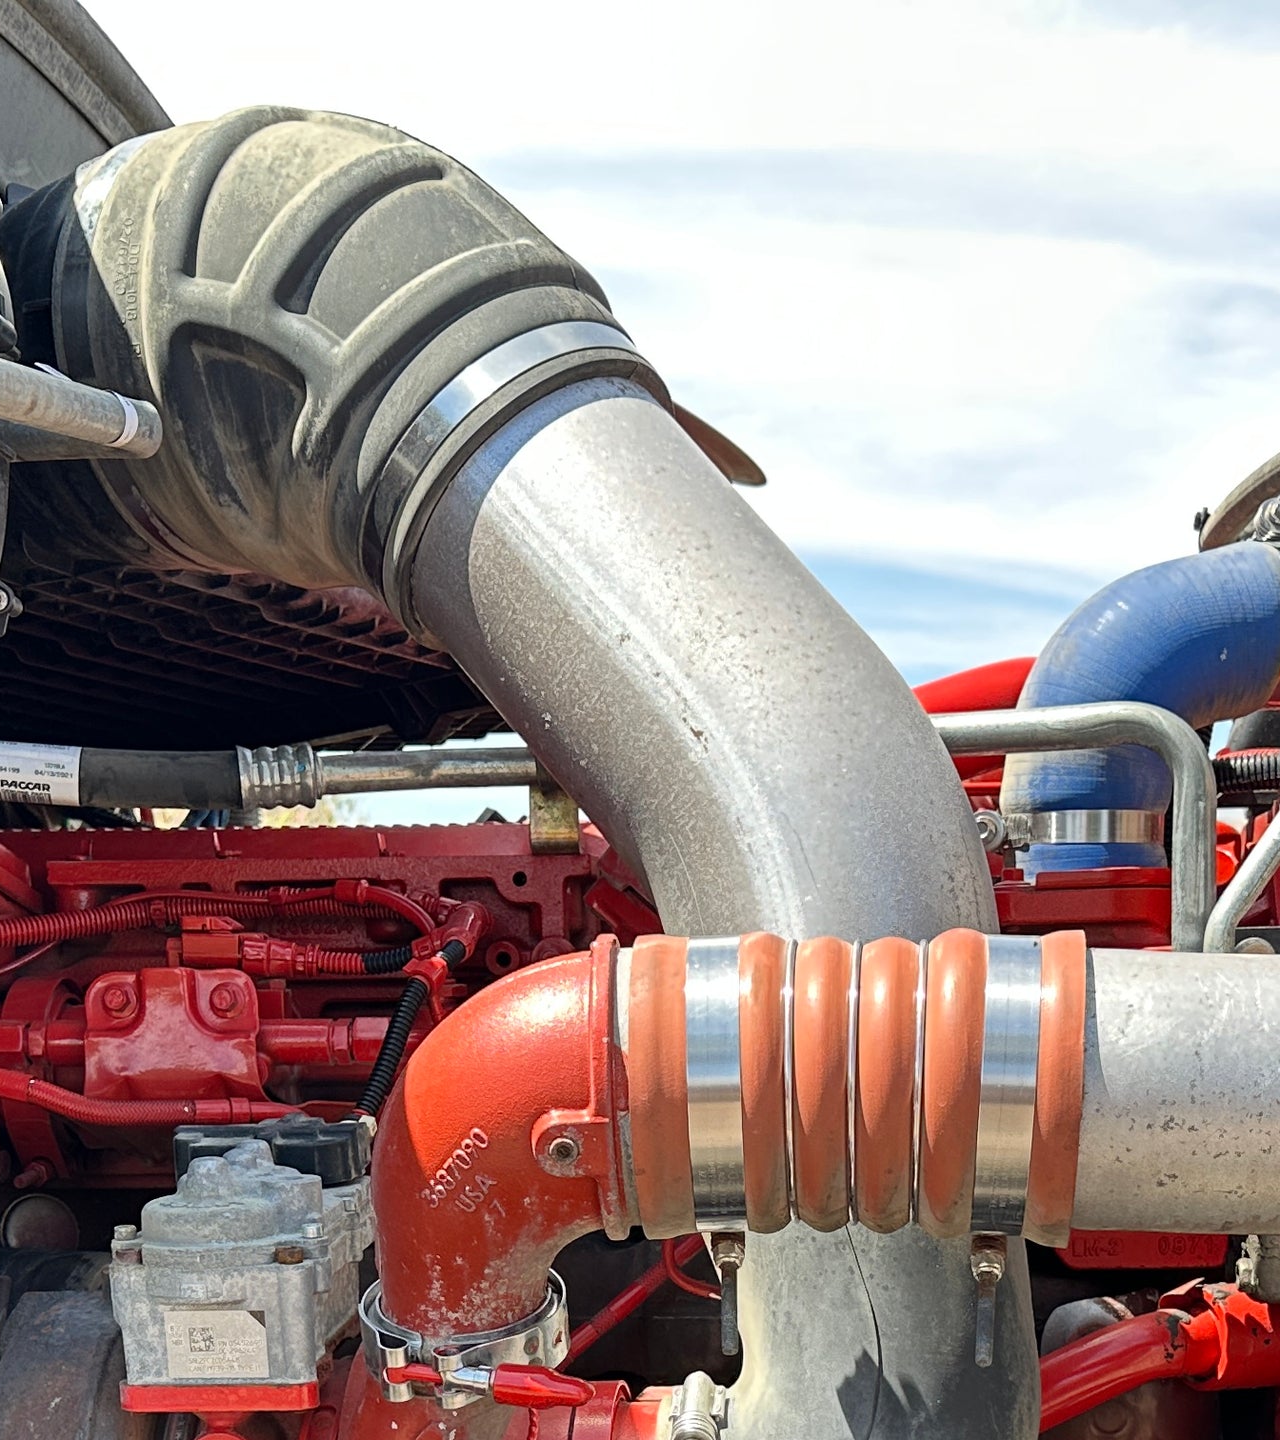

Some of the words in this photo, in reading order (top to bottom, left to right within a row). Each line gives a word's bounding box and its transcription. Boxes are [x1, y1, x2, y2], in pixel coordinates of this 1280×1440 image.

[0, 779, 51, 792] PACCAR
[420, 1127, 488, 1208] 3687090
[454, 1175, 497, 1212] USA
